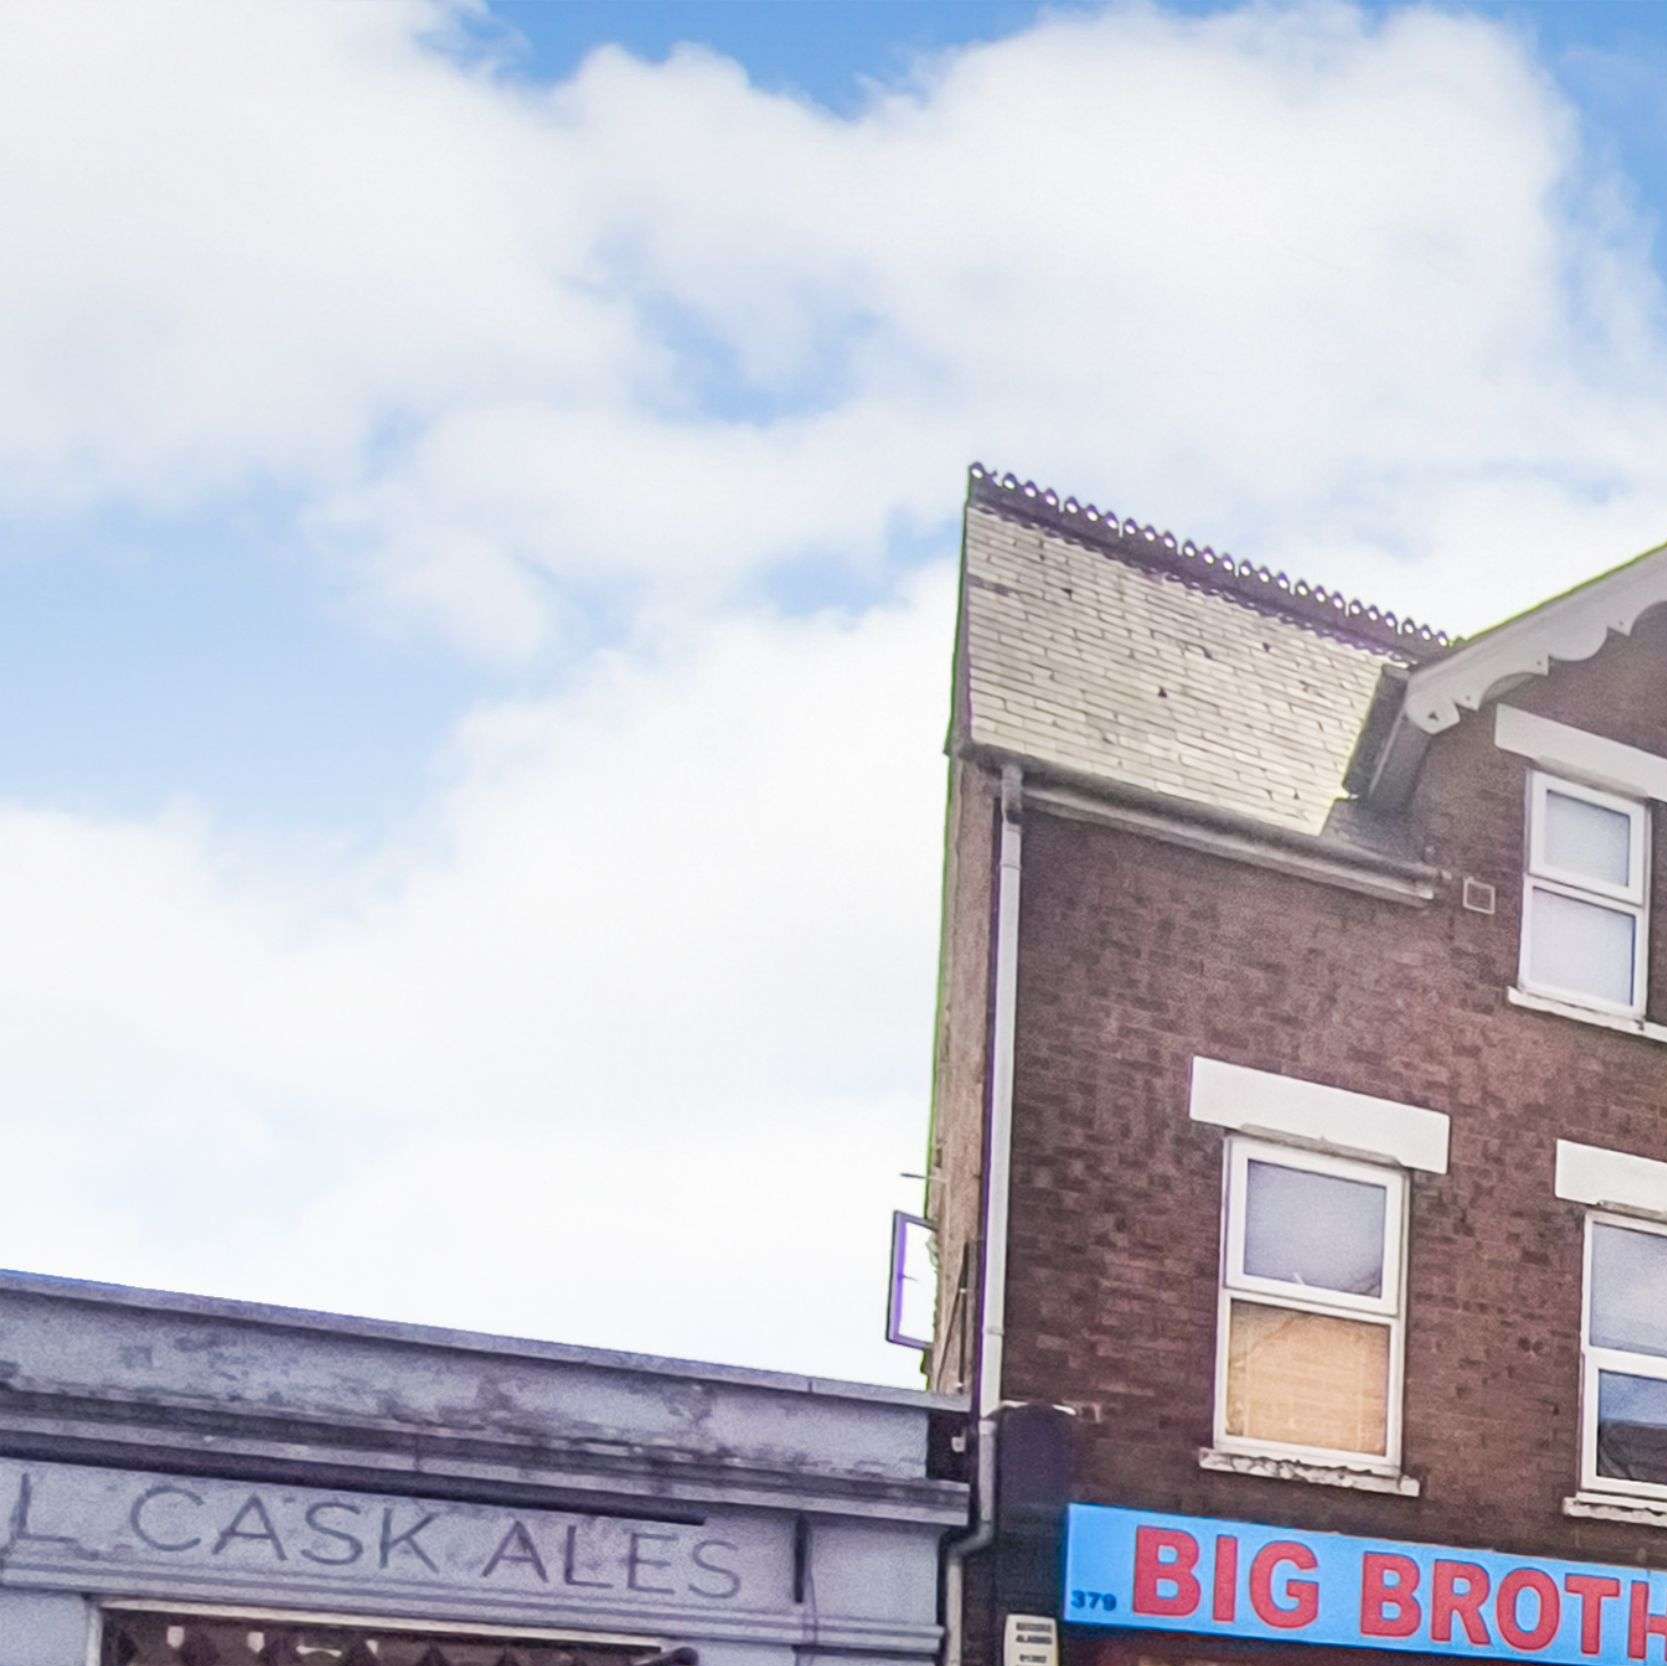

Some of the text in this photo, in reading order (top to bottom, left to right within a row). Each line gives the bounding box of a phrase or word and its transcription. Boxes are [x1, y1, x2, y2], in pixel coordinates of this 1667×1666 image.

[129, 1486, 440, 1573] CASK
[481, 1519, 742, 1600] ALES
[1132, 1525, 1320, 1629] BIG
[1071, 1589, 1117, 1612] 379
